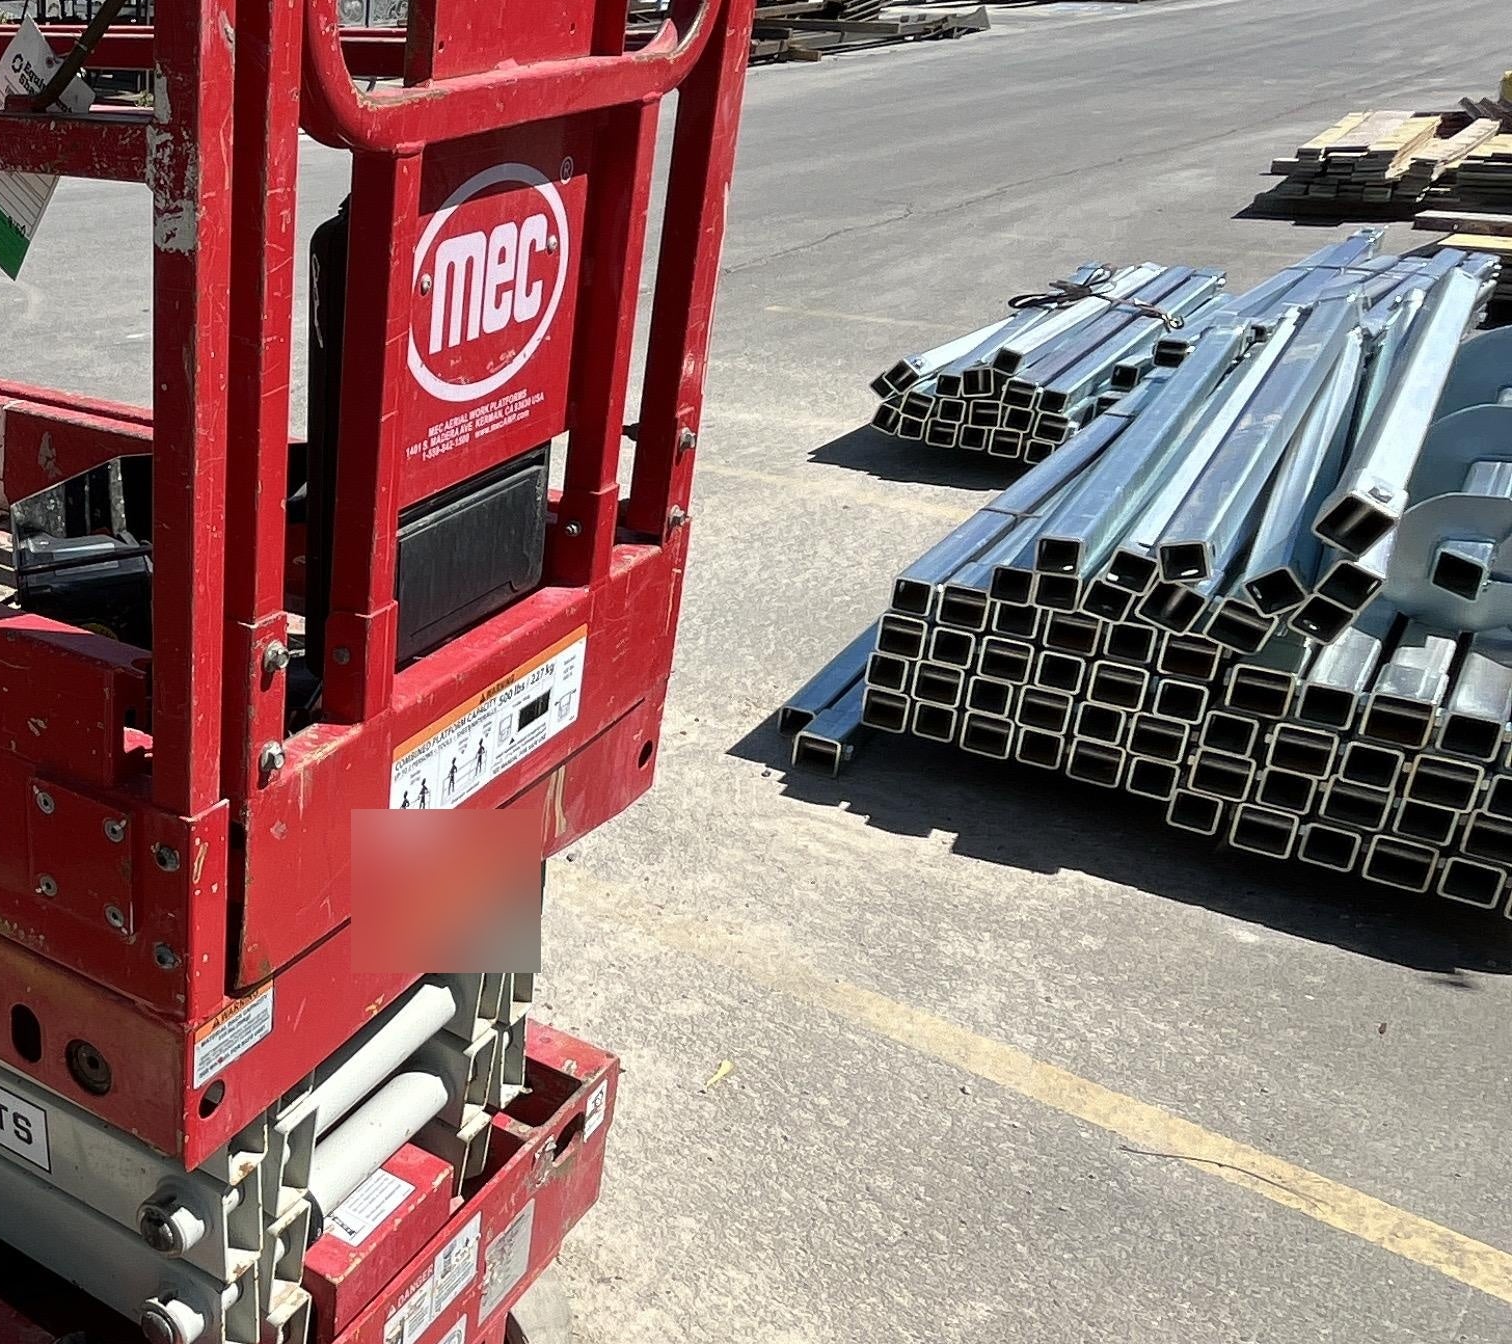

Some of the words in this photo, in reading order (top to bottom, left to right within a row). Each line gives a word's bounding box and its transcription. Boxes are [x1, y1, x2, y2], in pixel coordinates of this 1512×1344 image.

[498, 689, 513, 706] 500
[514, 682, 525, 696] lbs
[531, 667, 545, 685] 227
[545, 663, 555, 677] kg
[398, 1263, 434, 1308] DANGER
